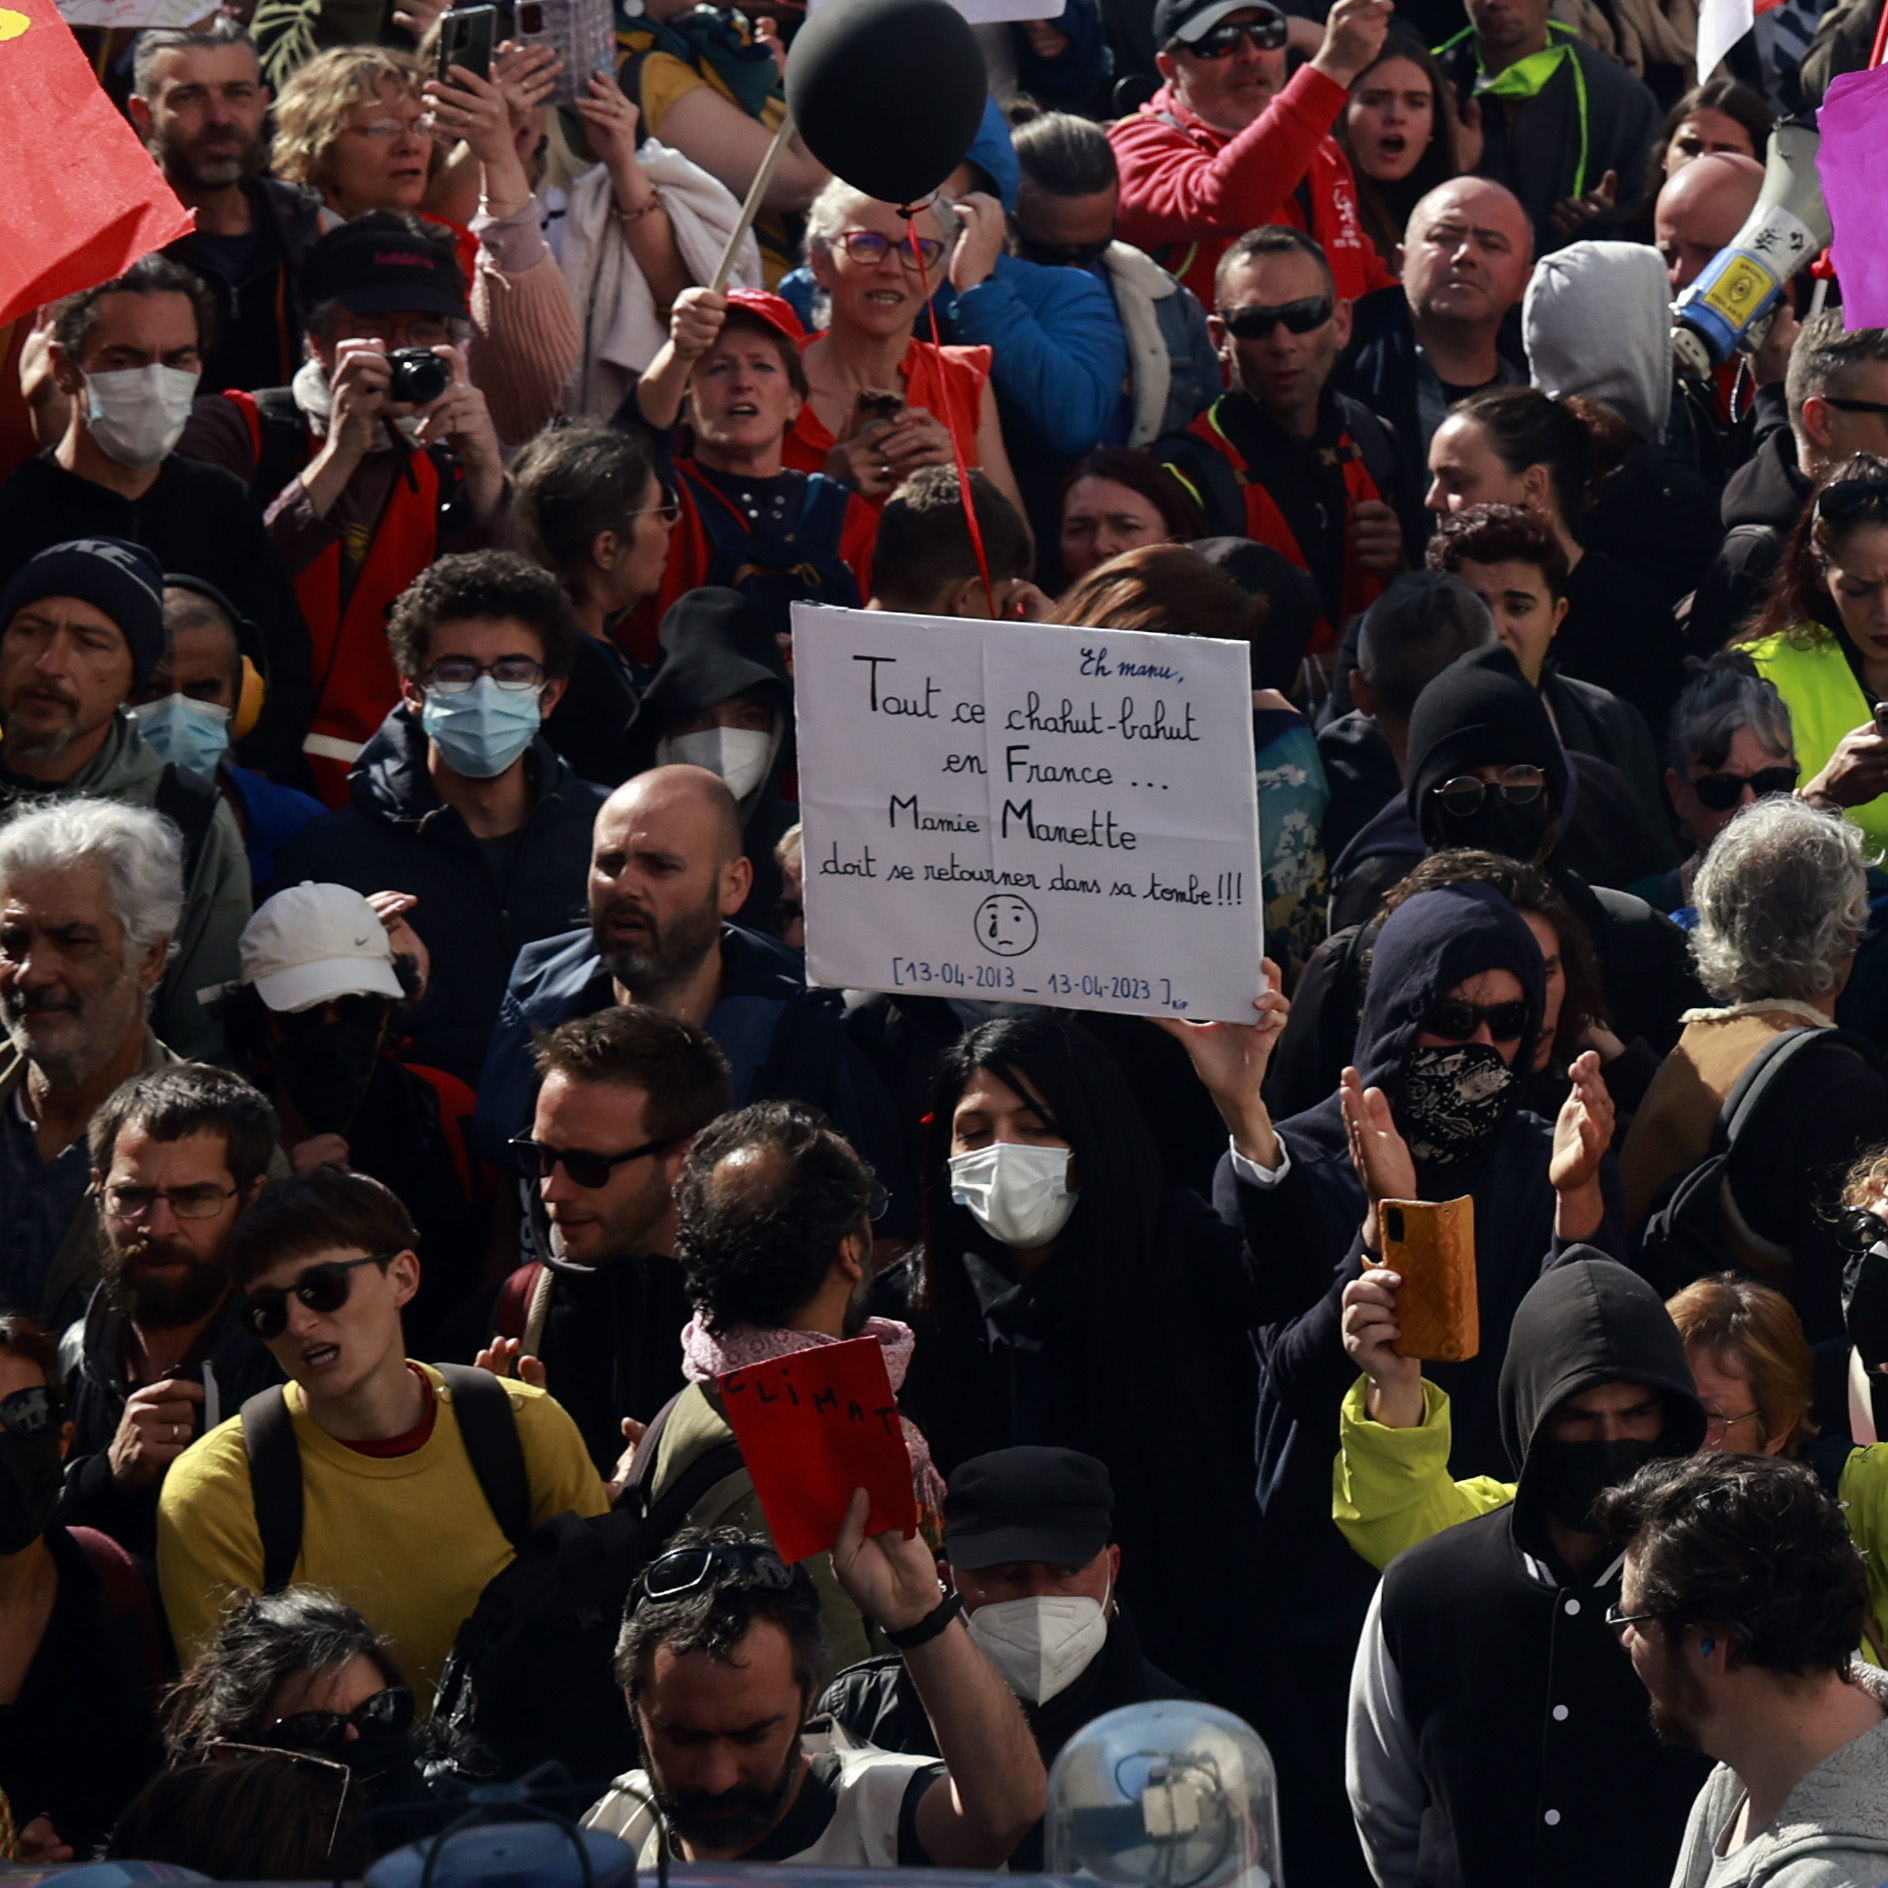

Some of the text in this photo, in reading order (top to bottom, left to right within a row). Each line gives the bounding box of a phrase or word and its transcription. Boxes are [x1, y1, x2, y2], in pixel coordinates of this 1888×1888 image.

[1080, 646, 1112, 677] Eh
[852, 654, 1201, 741] Tout ce chahut-bahut
[941, 752, 988, 776] en
[1006, 744, 1114, 786] France
[888, 794, 1138, 851] Mamie Manette
[818, 841, 878, 879] doit
[886, 863, 916, 882] se
[922, 852, 1042, 891] retourner
[1048, 863, 1102, 895] dans
[1109, 879, 1136, 898] sa
